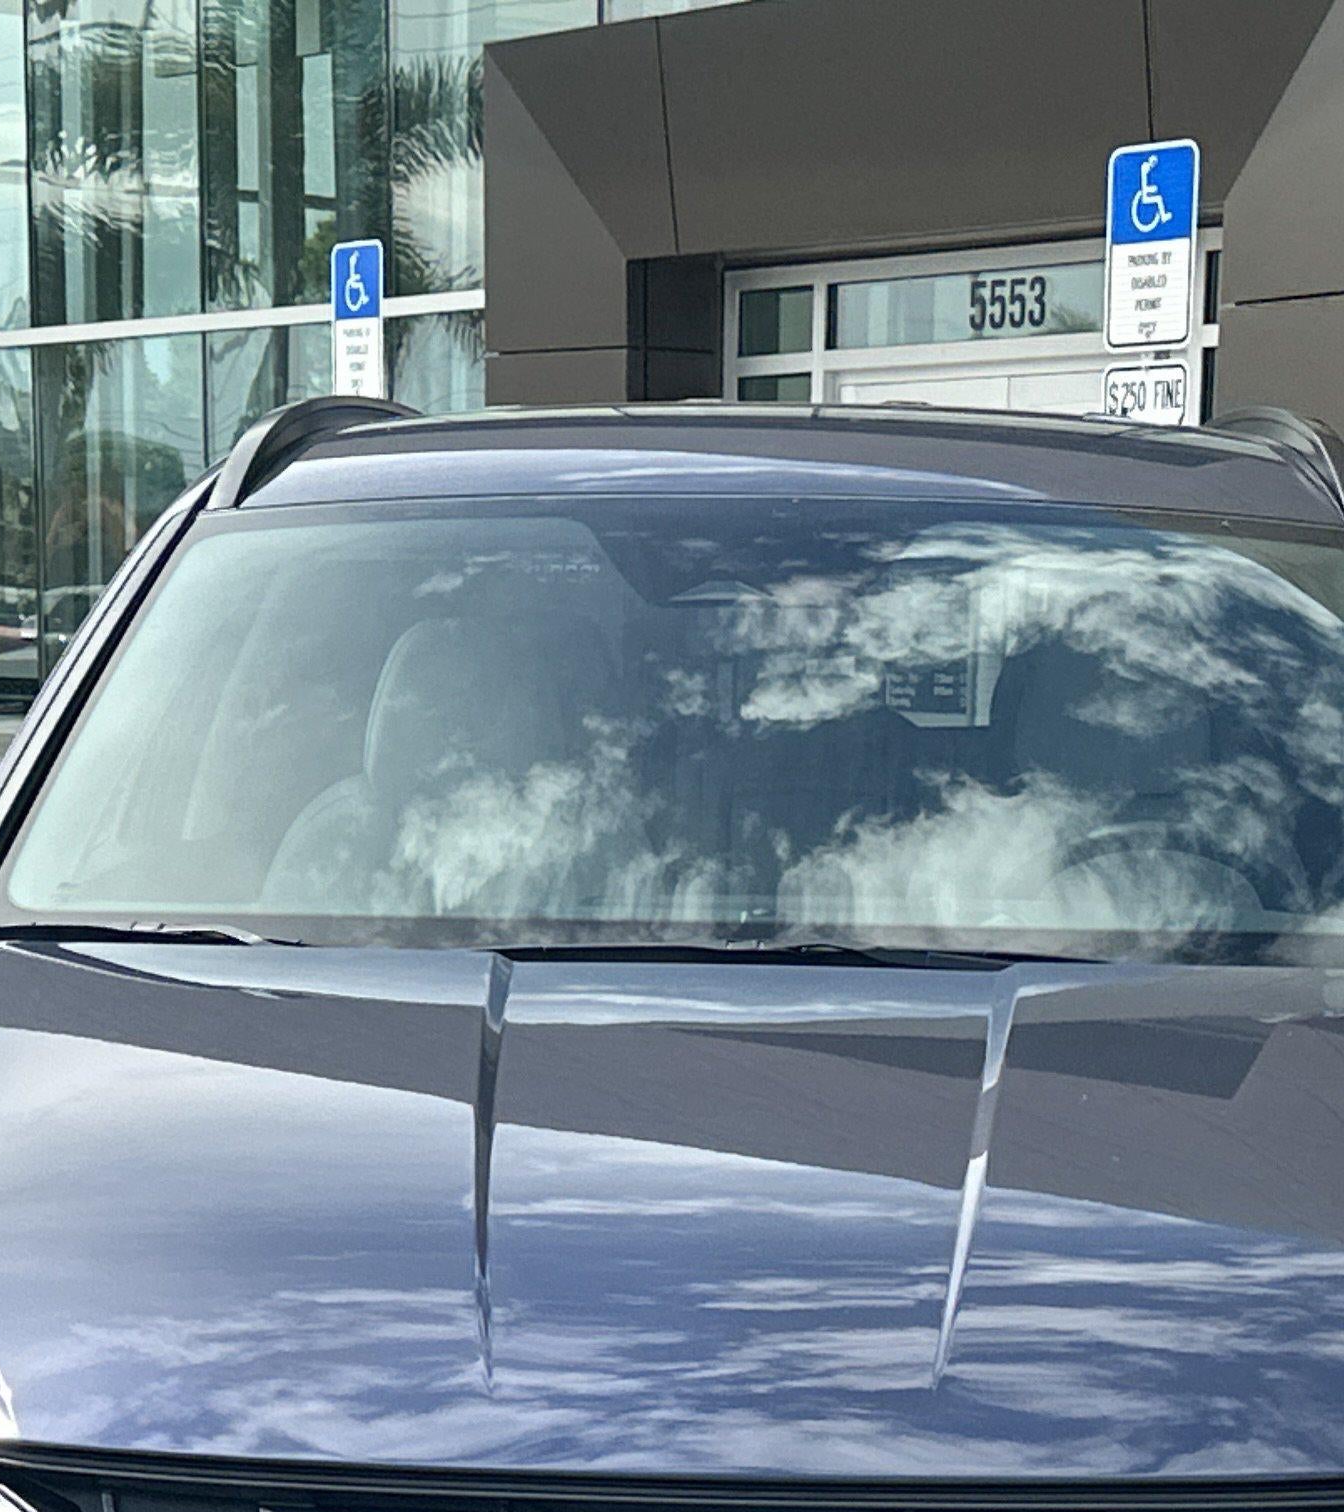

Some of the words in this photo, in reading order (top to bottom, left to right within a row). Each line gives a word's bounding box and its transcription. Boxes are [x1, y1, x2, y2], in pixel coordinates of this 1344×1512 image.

[969, 275, 1047, 331] 5553
[1109, 379, 1146, 415] $250
[1153, 378, 1183, 410] FINE
